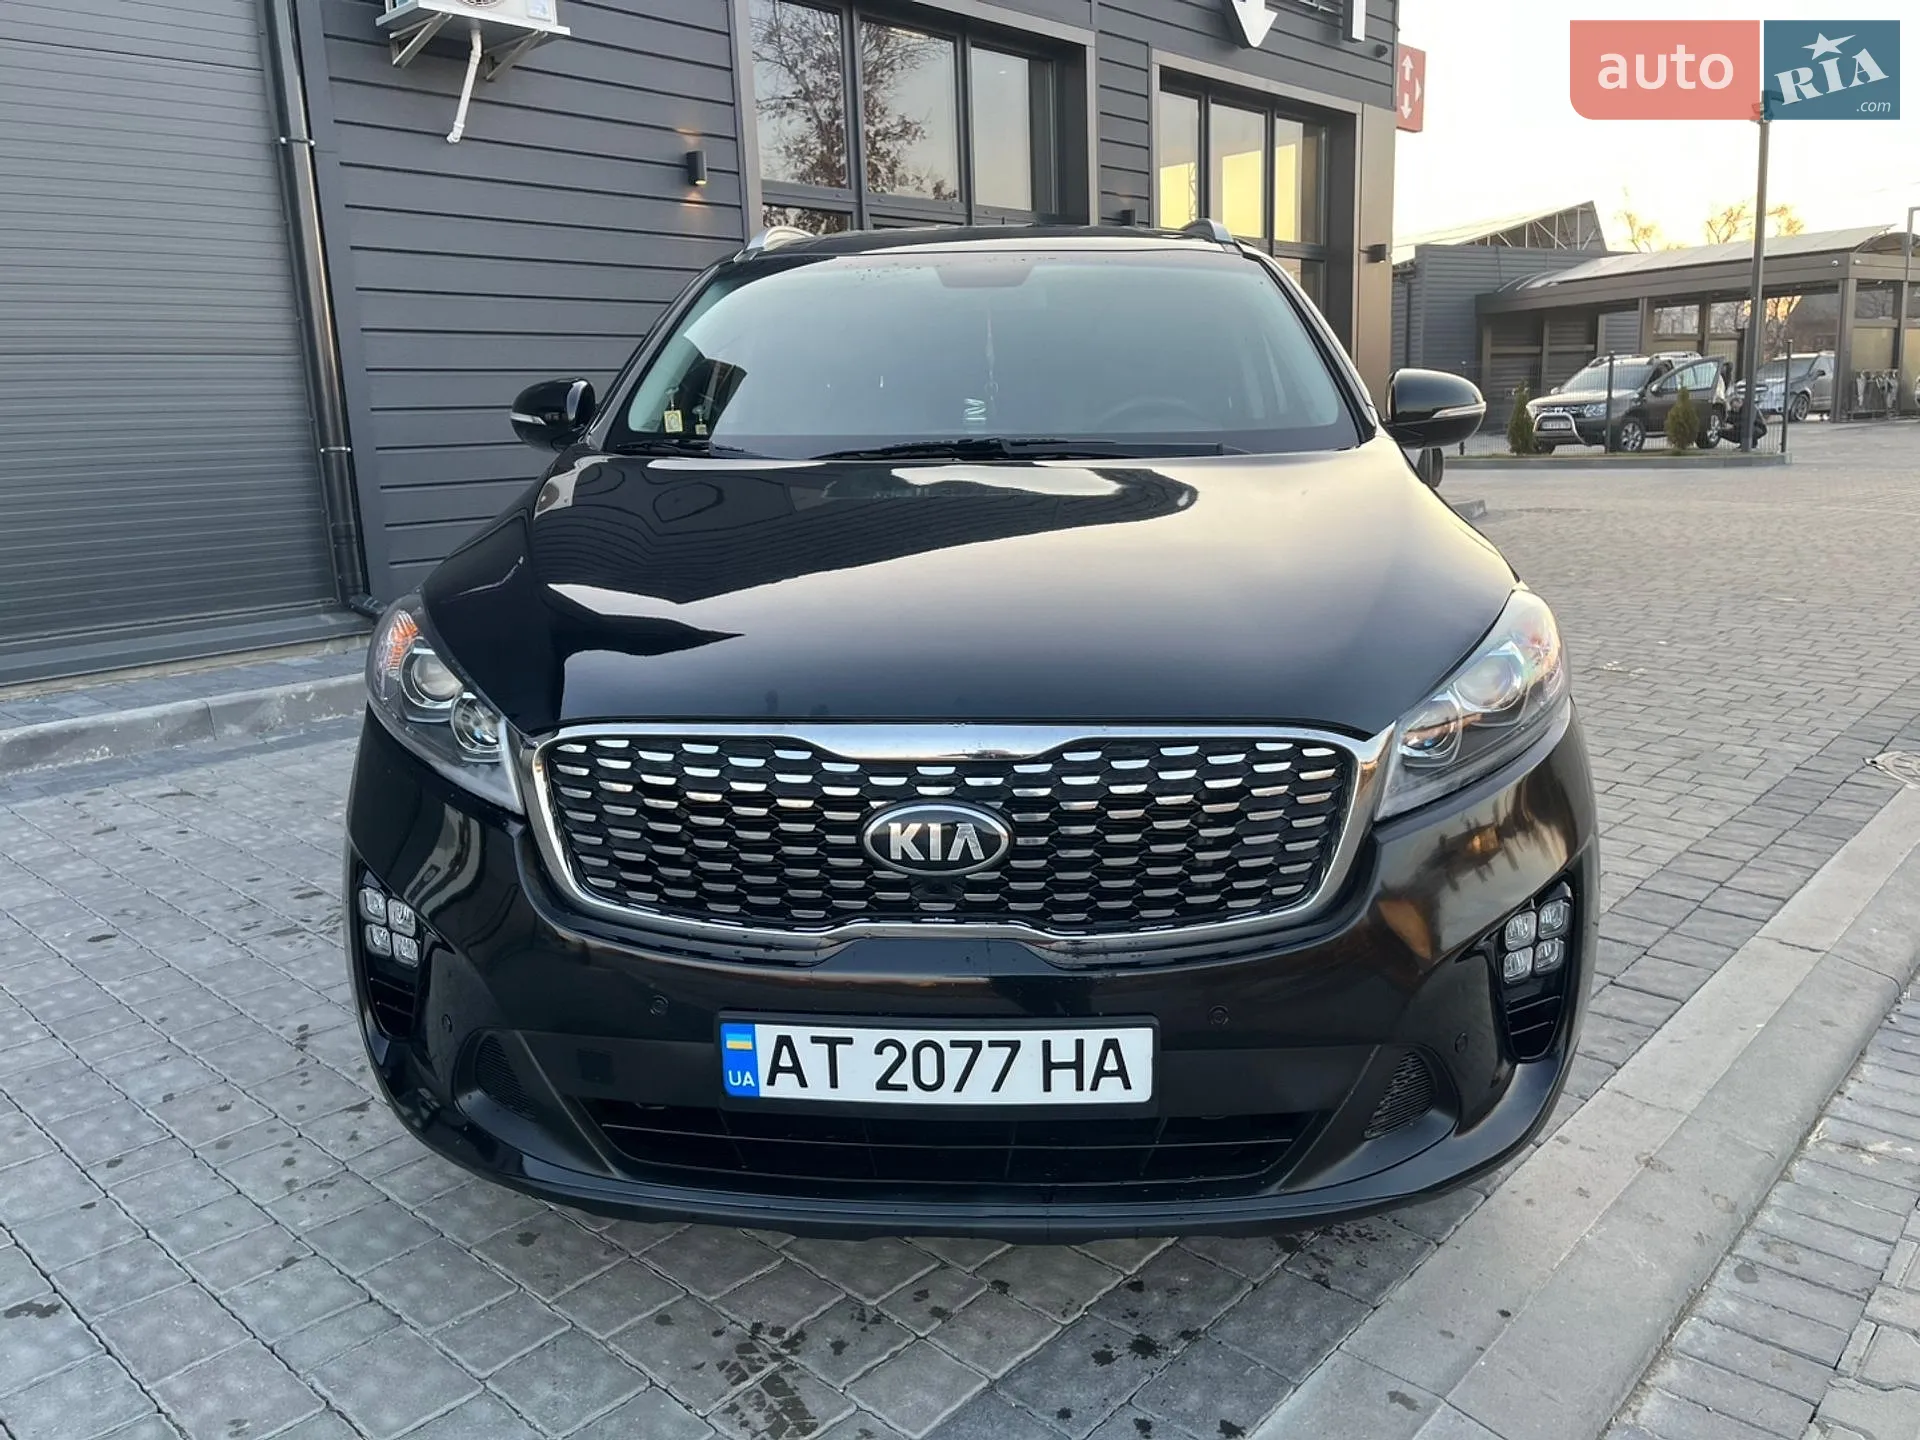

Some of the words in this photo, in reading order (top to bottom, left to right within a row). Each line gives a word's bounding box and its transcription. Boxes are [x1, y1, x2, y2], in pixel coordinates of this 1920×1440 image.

[888, 822, 986, 862] KIA
[728, 1069, 756, 1088] UA
[766, 1034, 855, 1090] AT
[873, 1038, 1022, 1093] 2077
[1042, 1037, 1133, 1093] HA
